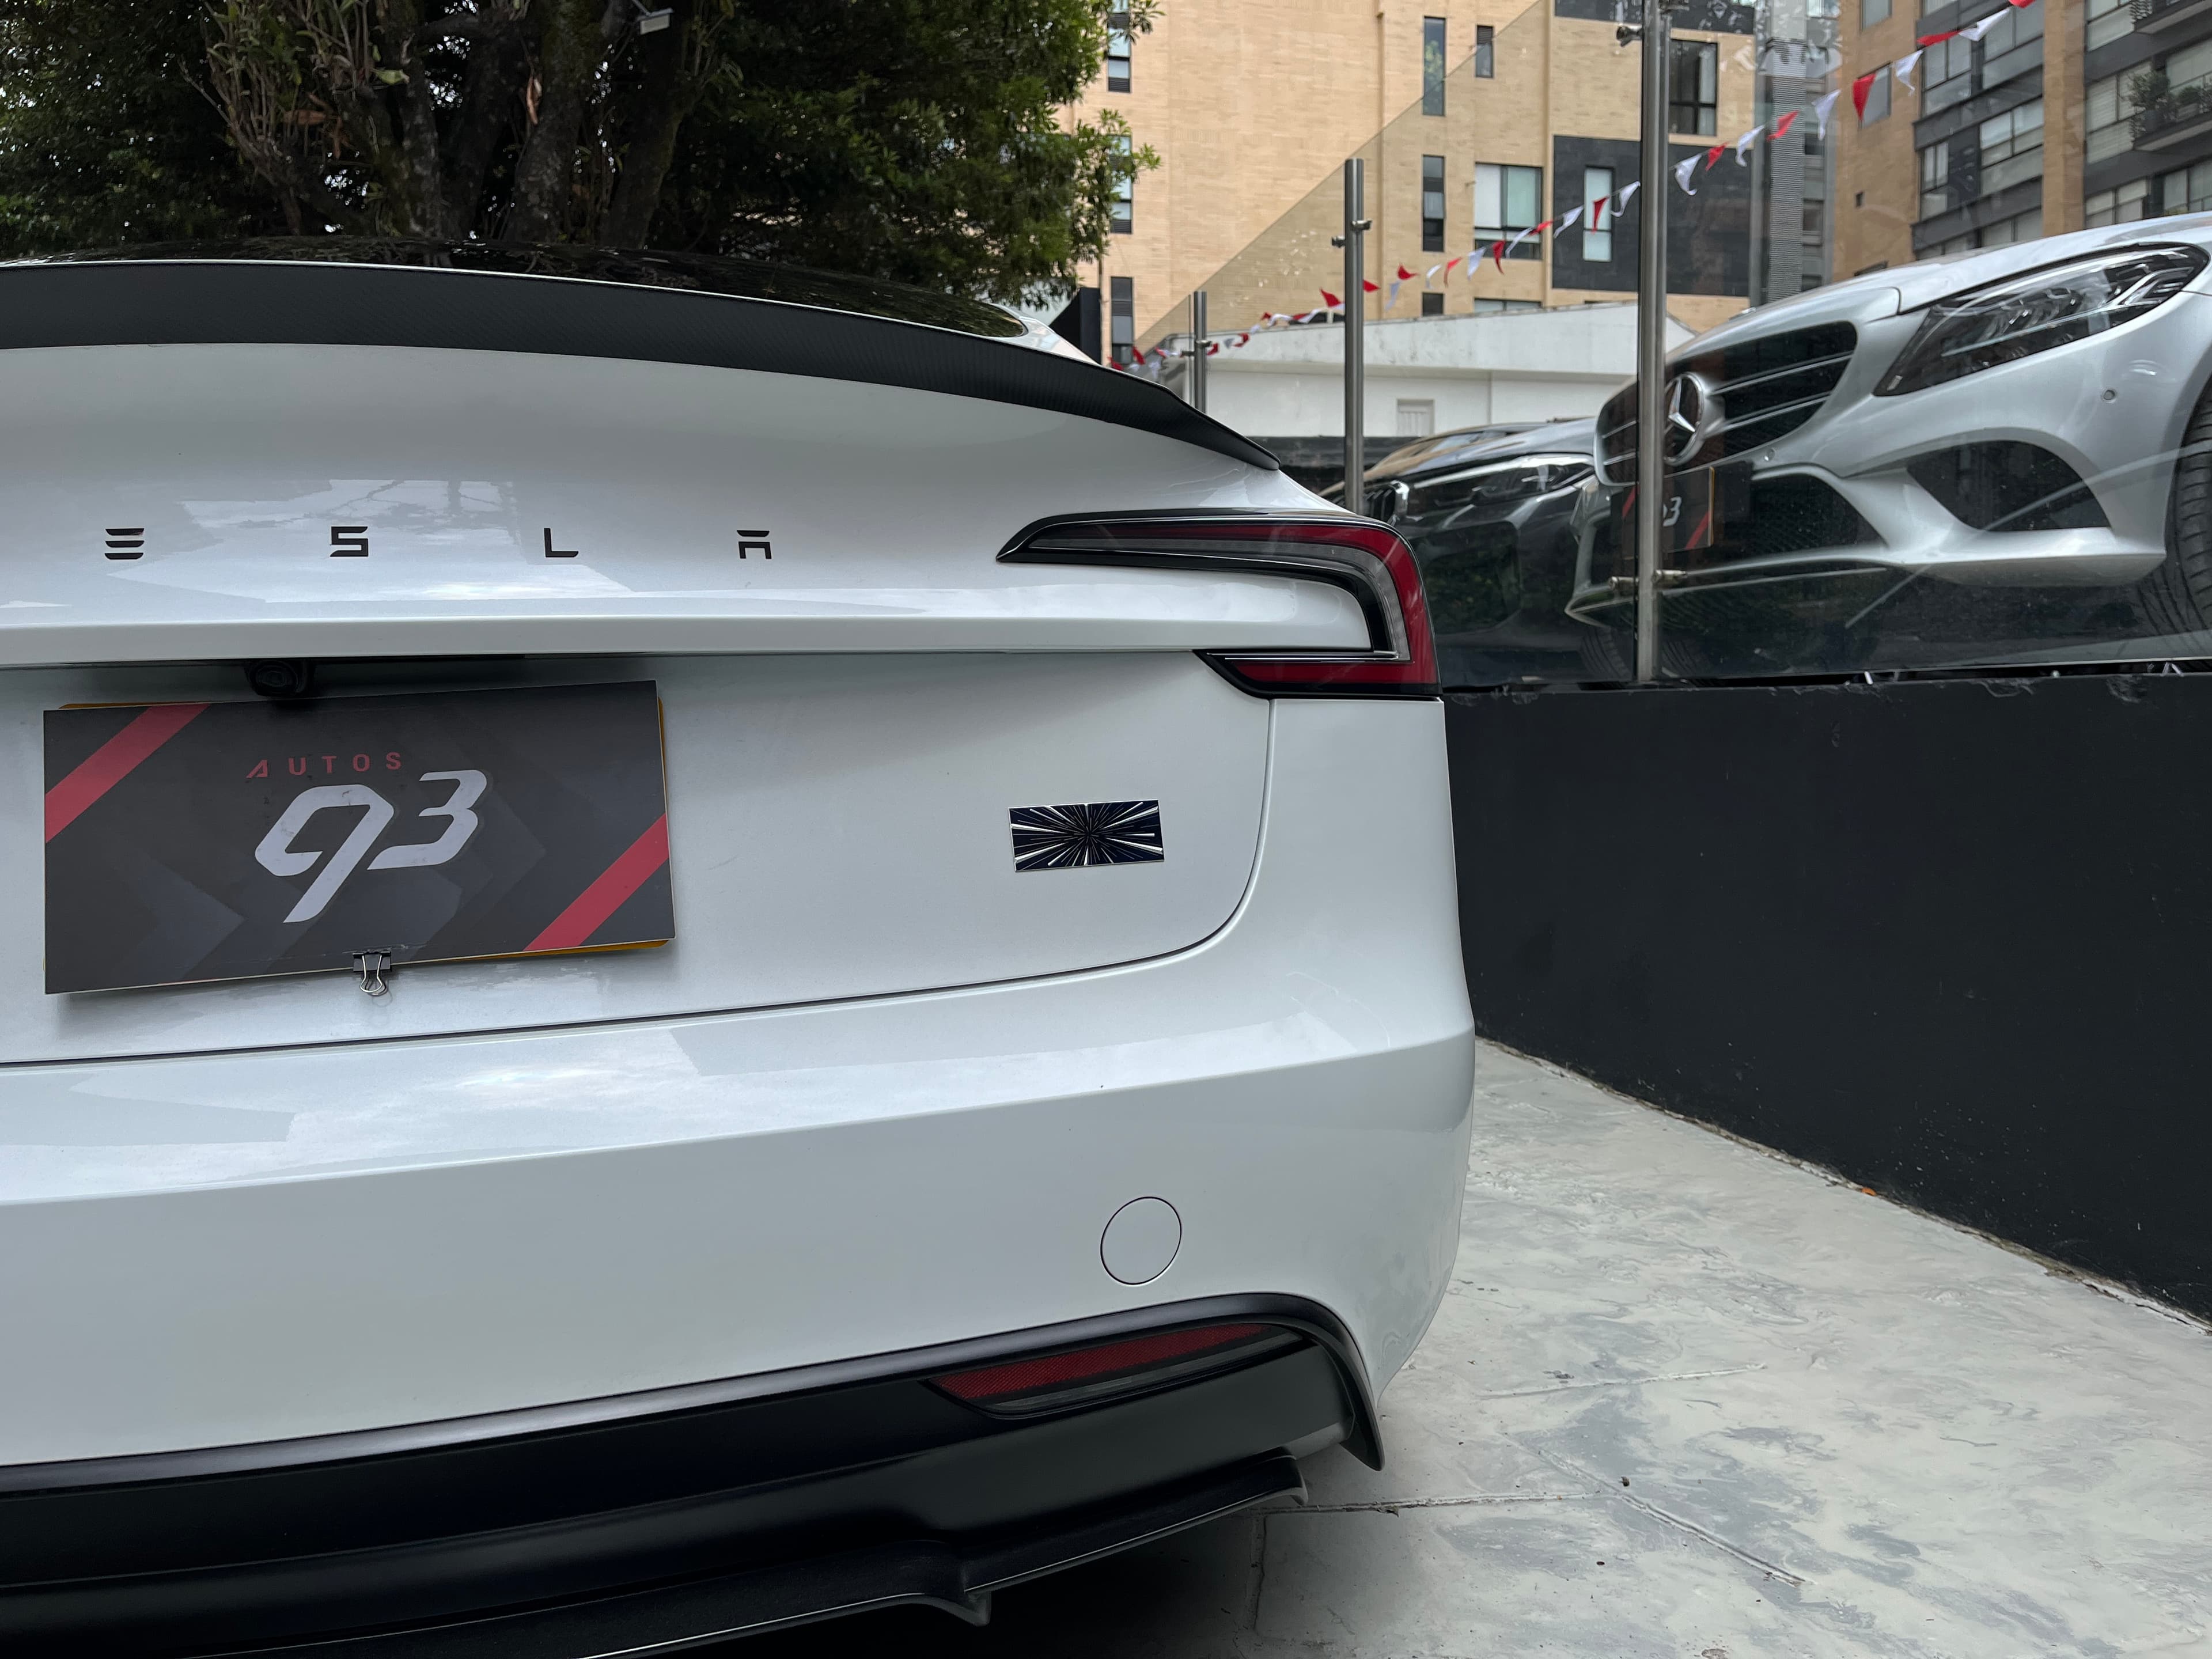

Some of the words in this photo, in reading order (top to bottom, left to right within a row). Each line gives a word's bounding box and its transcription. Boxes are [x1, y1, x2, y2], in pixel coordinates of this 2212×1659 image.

[1662, 497, 1682, 527] 3
[246, 752, 402, 779] AUTOS
[255, 770, 487, 923] 93
